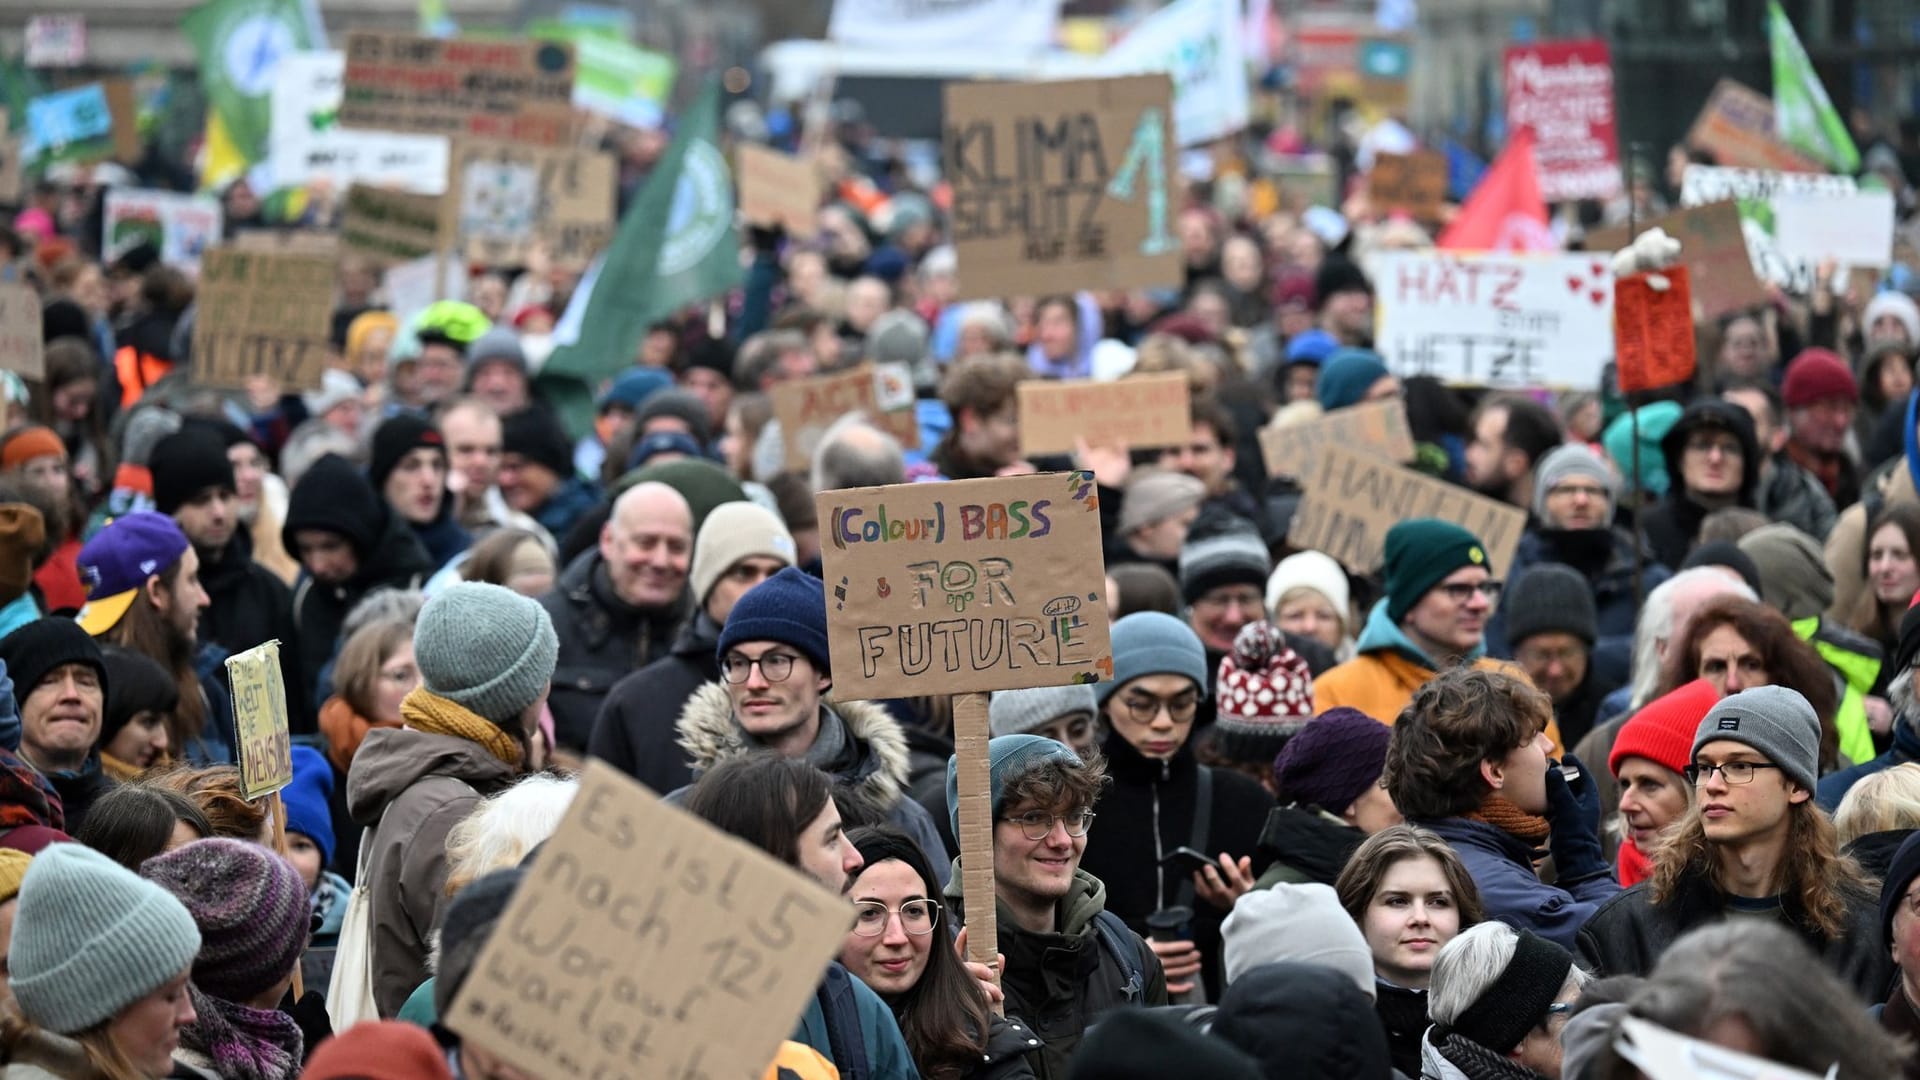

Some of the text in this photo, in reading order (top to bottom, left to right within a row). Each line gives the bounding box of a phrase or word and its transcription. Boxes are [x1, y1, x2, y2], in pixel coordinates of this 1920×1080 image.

[946, 112, 1109, 187] KLIMA
[1106, 104, 1182, 257] 1
[954, 184, 1104, 240] SCHUTZ
[1396, 333, 1546, 383] HETZE
[831, 500, 1051, 550] (Colour) BASS
[907, 557, 1016, 610] FOR
[858, 615, 1092, 678] FUTURE
[542, 850, 672, 950] nach
[577, 783, 638, 851] Es
[748, 892, 821, 952] 5
[510, 894, 709, 1023] Worauf
